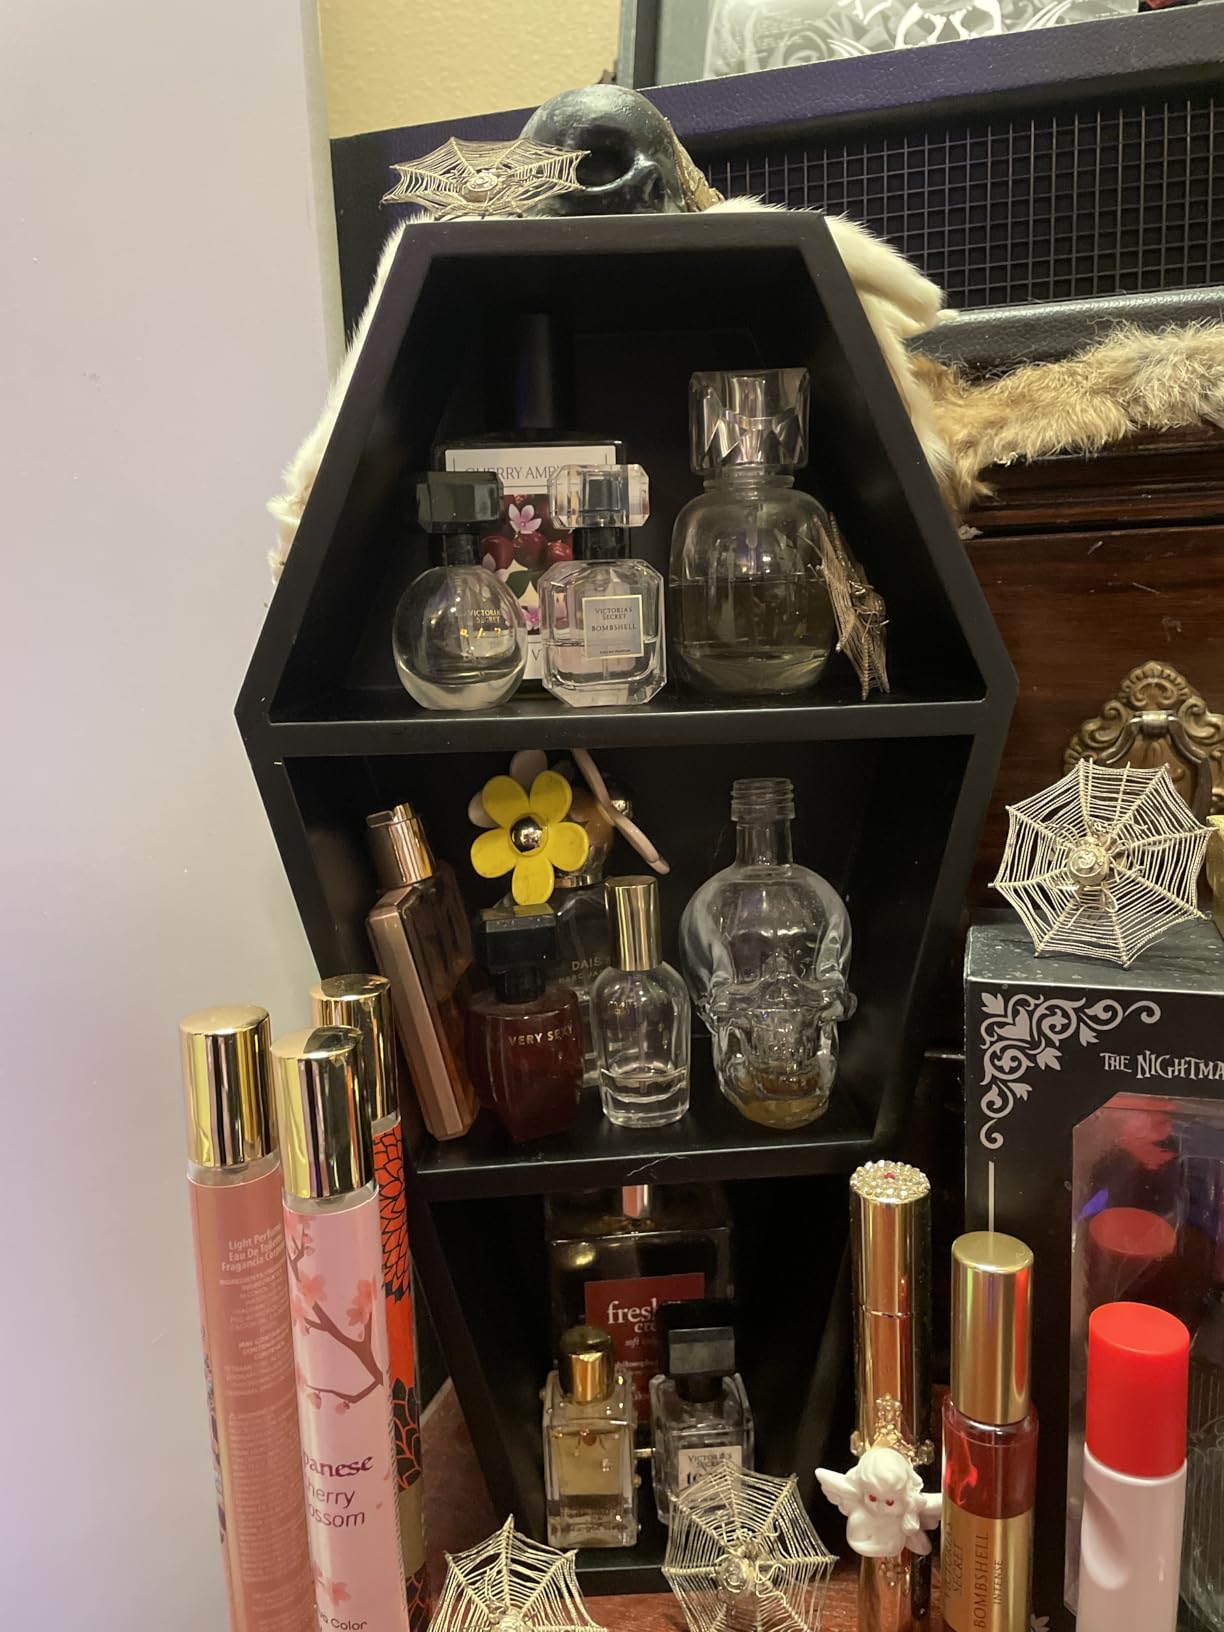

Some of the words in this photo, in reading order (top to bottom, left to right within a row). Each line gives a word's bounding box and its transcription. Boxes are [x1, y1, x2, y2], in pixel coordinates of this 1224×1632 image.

[602, 613, 626, 621] SECRET
[591, 623, 637, 632] BOMBSHELL
[508, 1032, 543, 1046] VERY
[1099, 1052, 1133, 1073] THE
[228, 1237, 253, 1252] Light
[229, 1251, 245, 1262] Eau
[248, 1247, 259, 1258] De
[973, 1531, 989, 1629] BOMBSHELL
[993, 1559, 1003, 1605] INTENSE
[330, 1617, 369, 1632] Color
